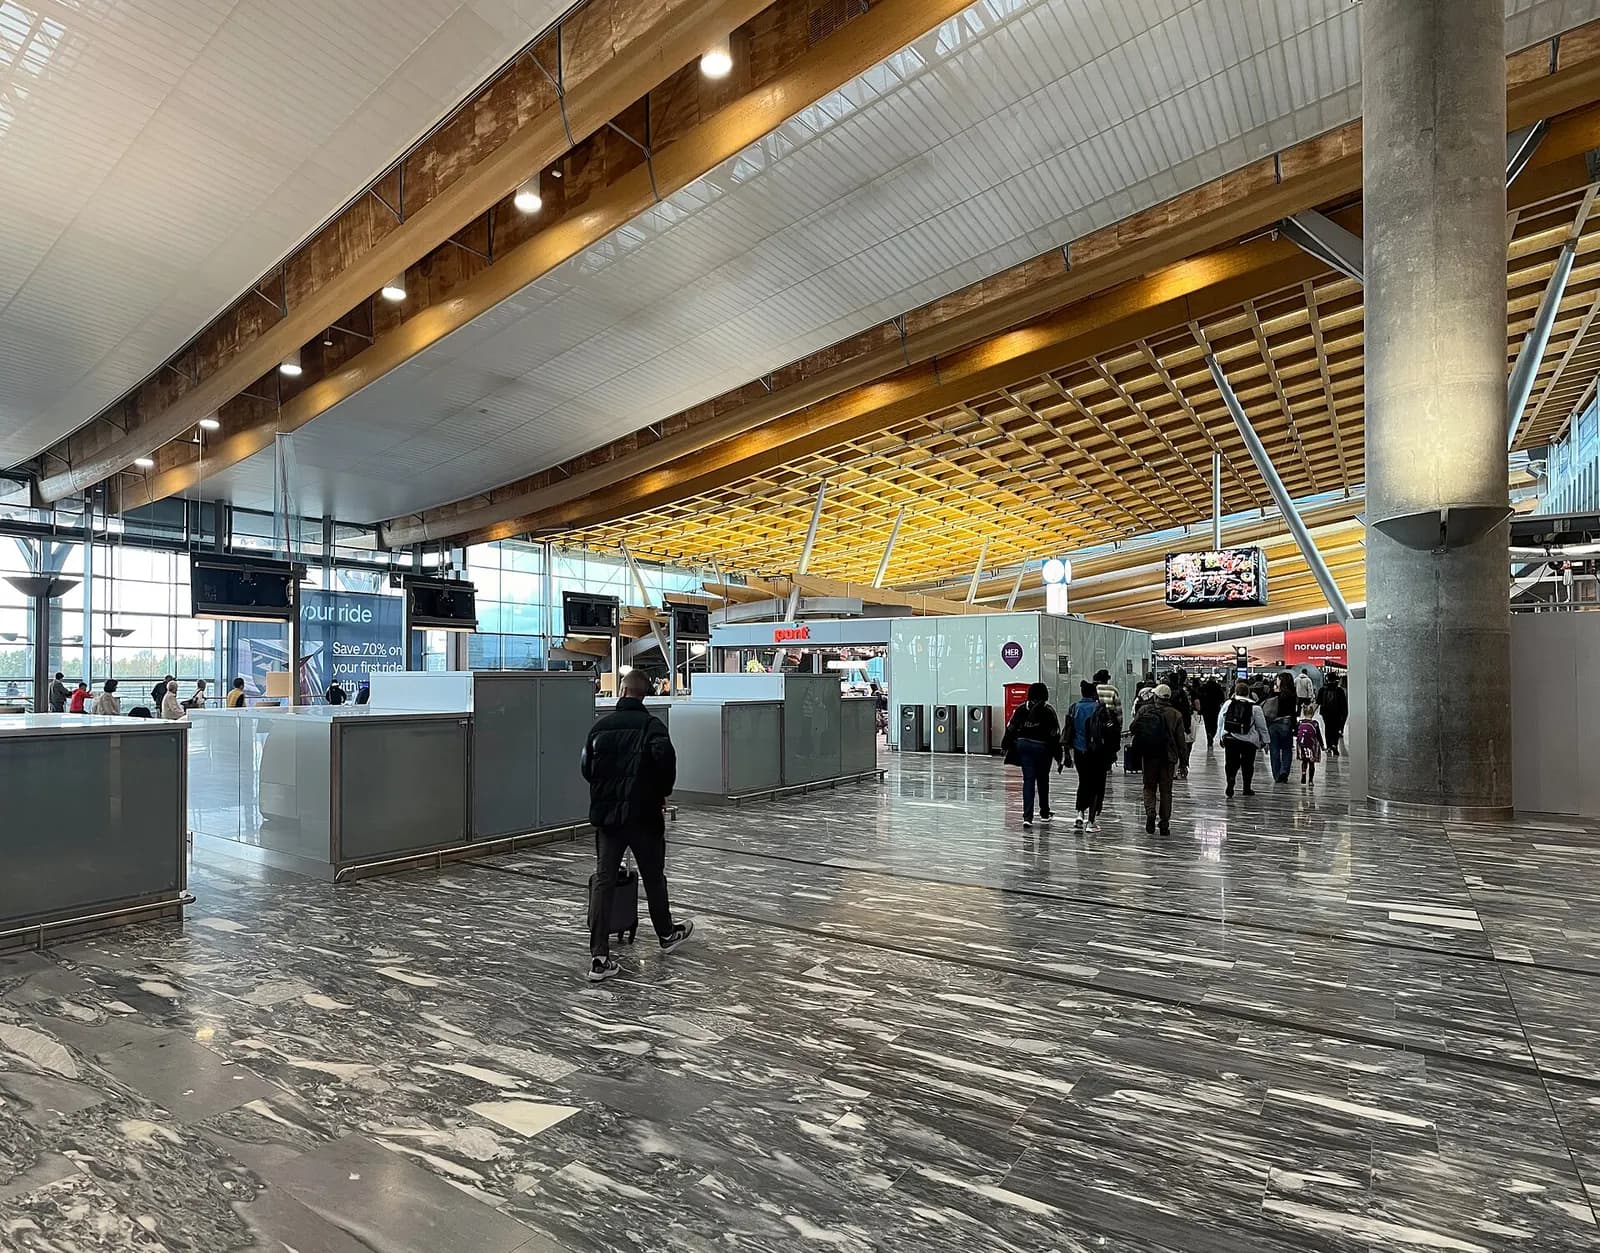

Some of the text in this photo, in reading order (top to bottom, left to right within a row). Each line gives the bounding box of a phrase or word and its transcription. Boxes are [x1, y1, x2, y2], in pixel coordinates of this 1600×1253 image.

[338, 604, 372, 623] ride
[332, 641, 403, 656] Save 70% on
[1004, 648, 1019, 656] HER
[1294, 641, 1347, 651] norwegian
[332, 660, 403, 676] your first ride
